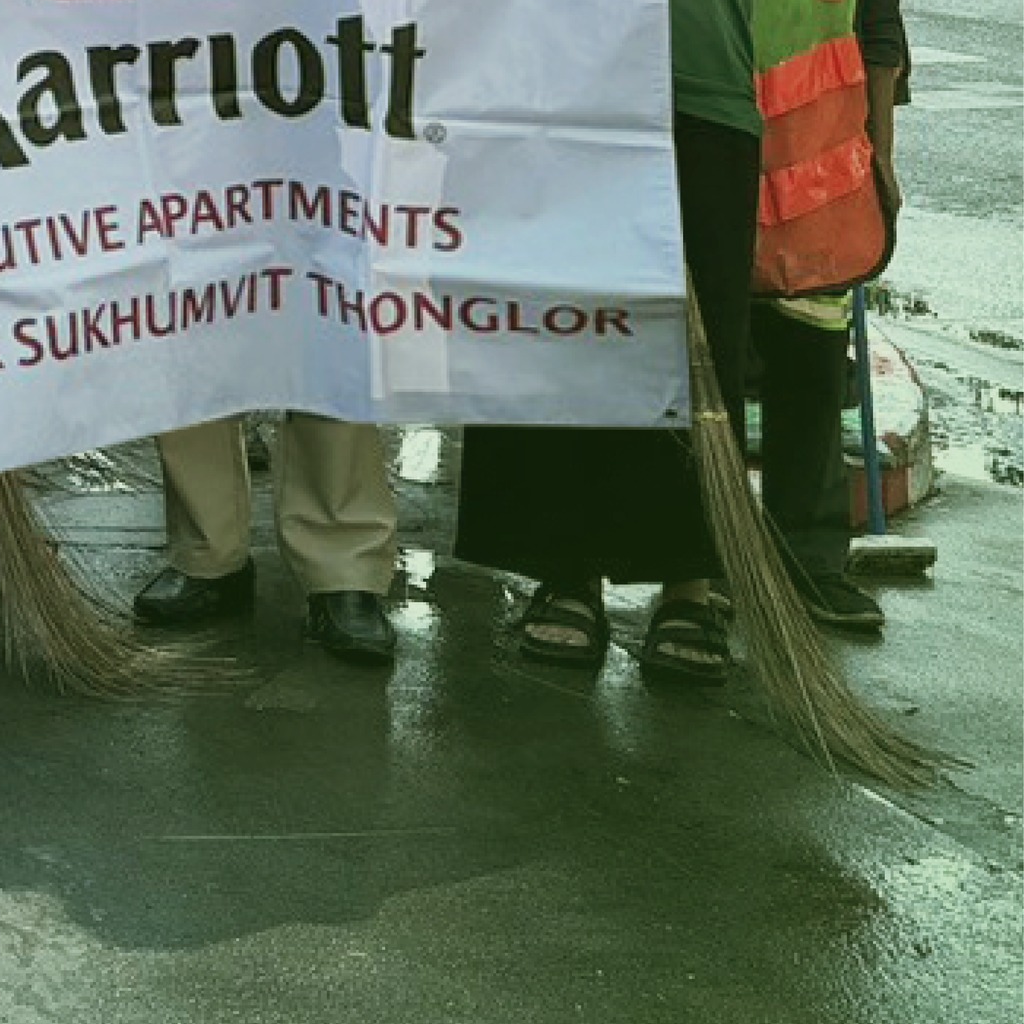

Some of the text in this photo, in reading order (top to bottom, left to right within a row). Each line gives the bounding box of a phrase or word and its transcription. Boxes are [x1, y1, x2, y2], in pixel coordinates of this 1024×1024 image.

[137, 178, 463, 252] APARTMENTS
[12, 268, 293, 366] SUKHUMVIT
[306, 271, 634, 337] THONGLOR
